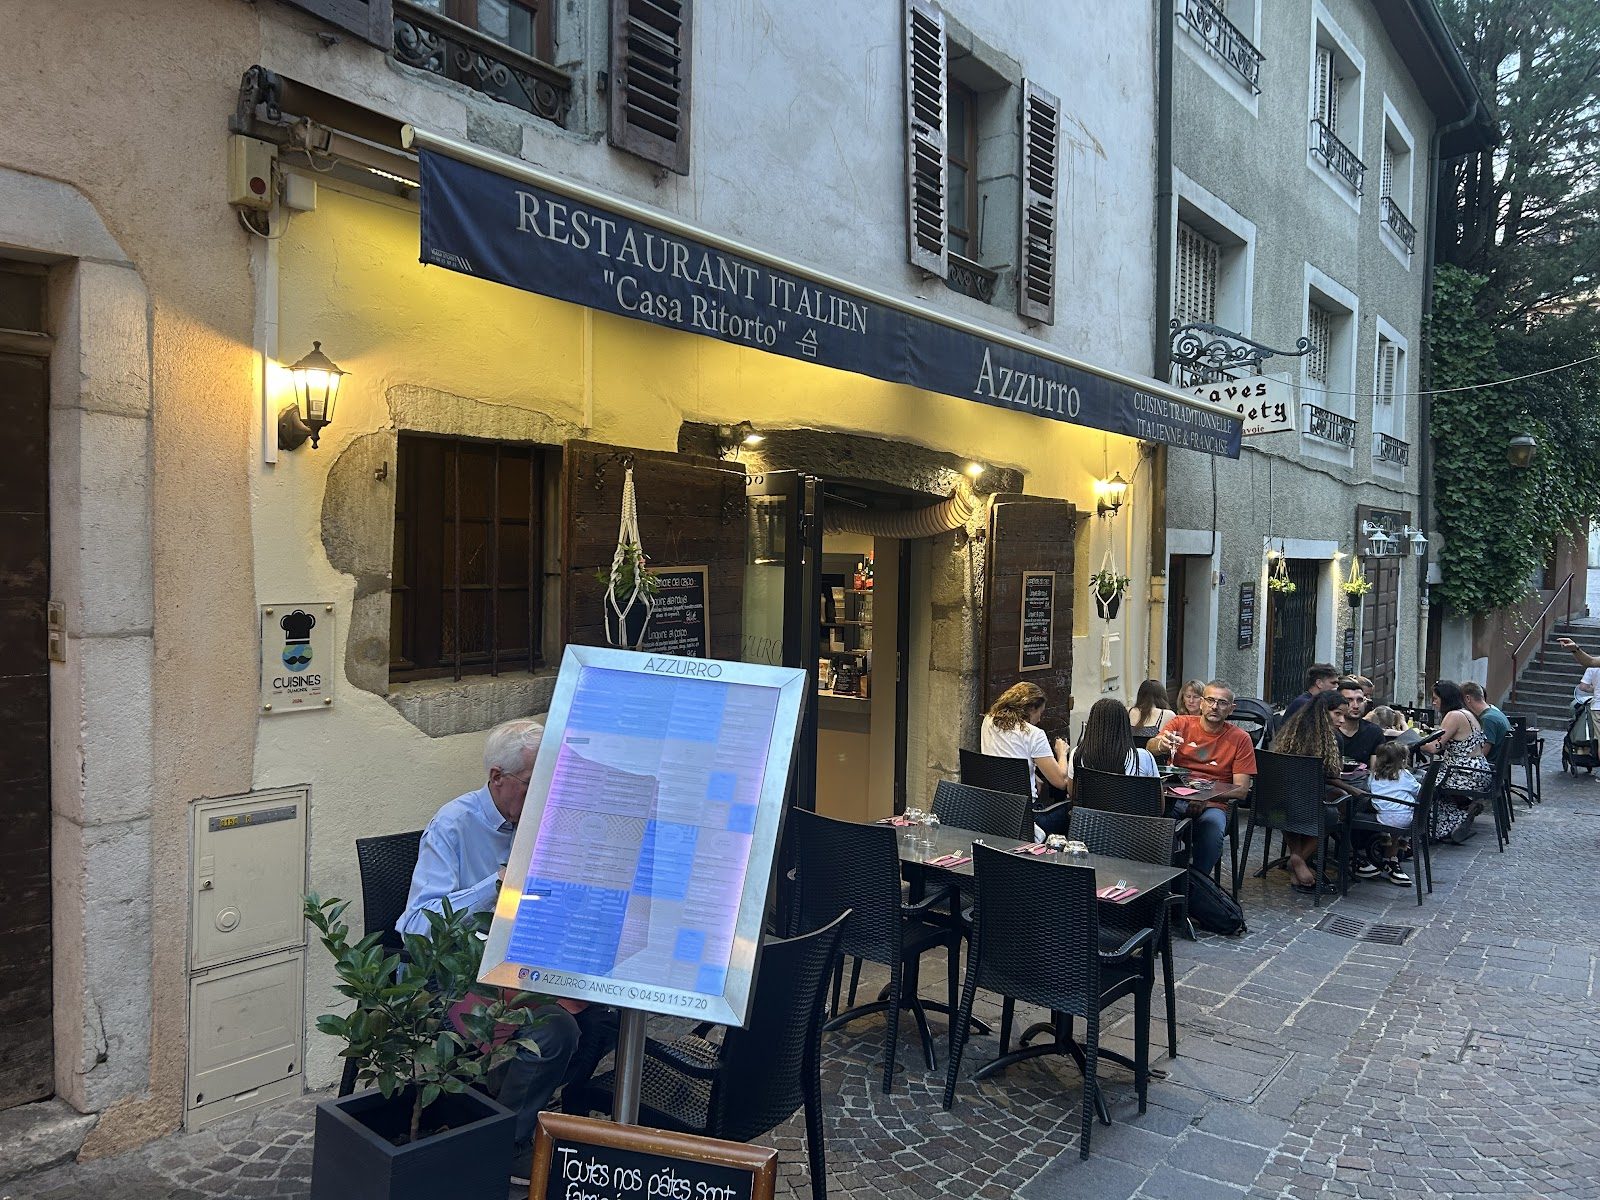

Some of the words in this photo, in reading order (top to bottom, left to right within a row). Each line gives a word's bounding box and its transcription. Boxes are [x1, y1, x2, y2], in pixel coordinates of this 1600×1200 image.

[514, 190, 759, 301] RESTAURANT
[769, 273, 869, 335] ITALIEN
[603, 269, 683, 323] "Casa
[692, 294, 787, 347] Ritorto"
[974, 347, 1080, 418] Azzurro
[1134, 391, 1168, 418] CUISINE
[1169, 402, 1232, 434] TRADITIONNELLE
[1137, 418, 1181, 444] ITALIENNE
[1182, 431, 1189, 446] &
[272, 674, 321, 688] CUISINES
[643, 657, 722, 679] AZZURRO
[541, 973, 588, 990] AZZURRO
[589, 982, 625, 997] ANNECY
[639, 990, 652, 1000] 04
[652, 991, 666, 1003] 50
[667, 993, 679, 1006] 11
[680, 995, 694, 1008] 57
[694, 998, 708, 1010] 20
[557, 1147, 609, 1187] Toutes
[613, 1167, 642, 1191] nos
